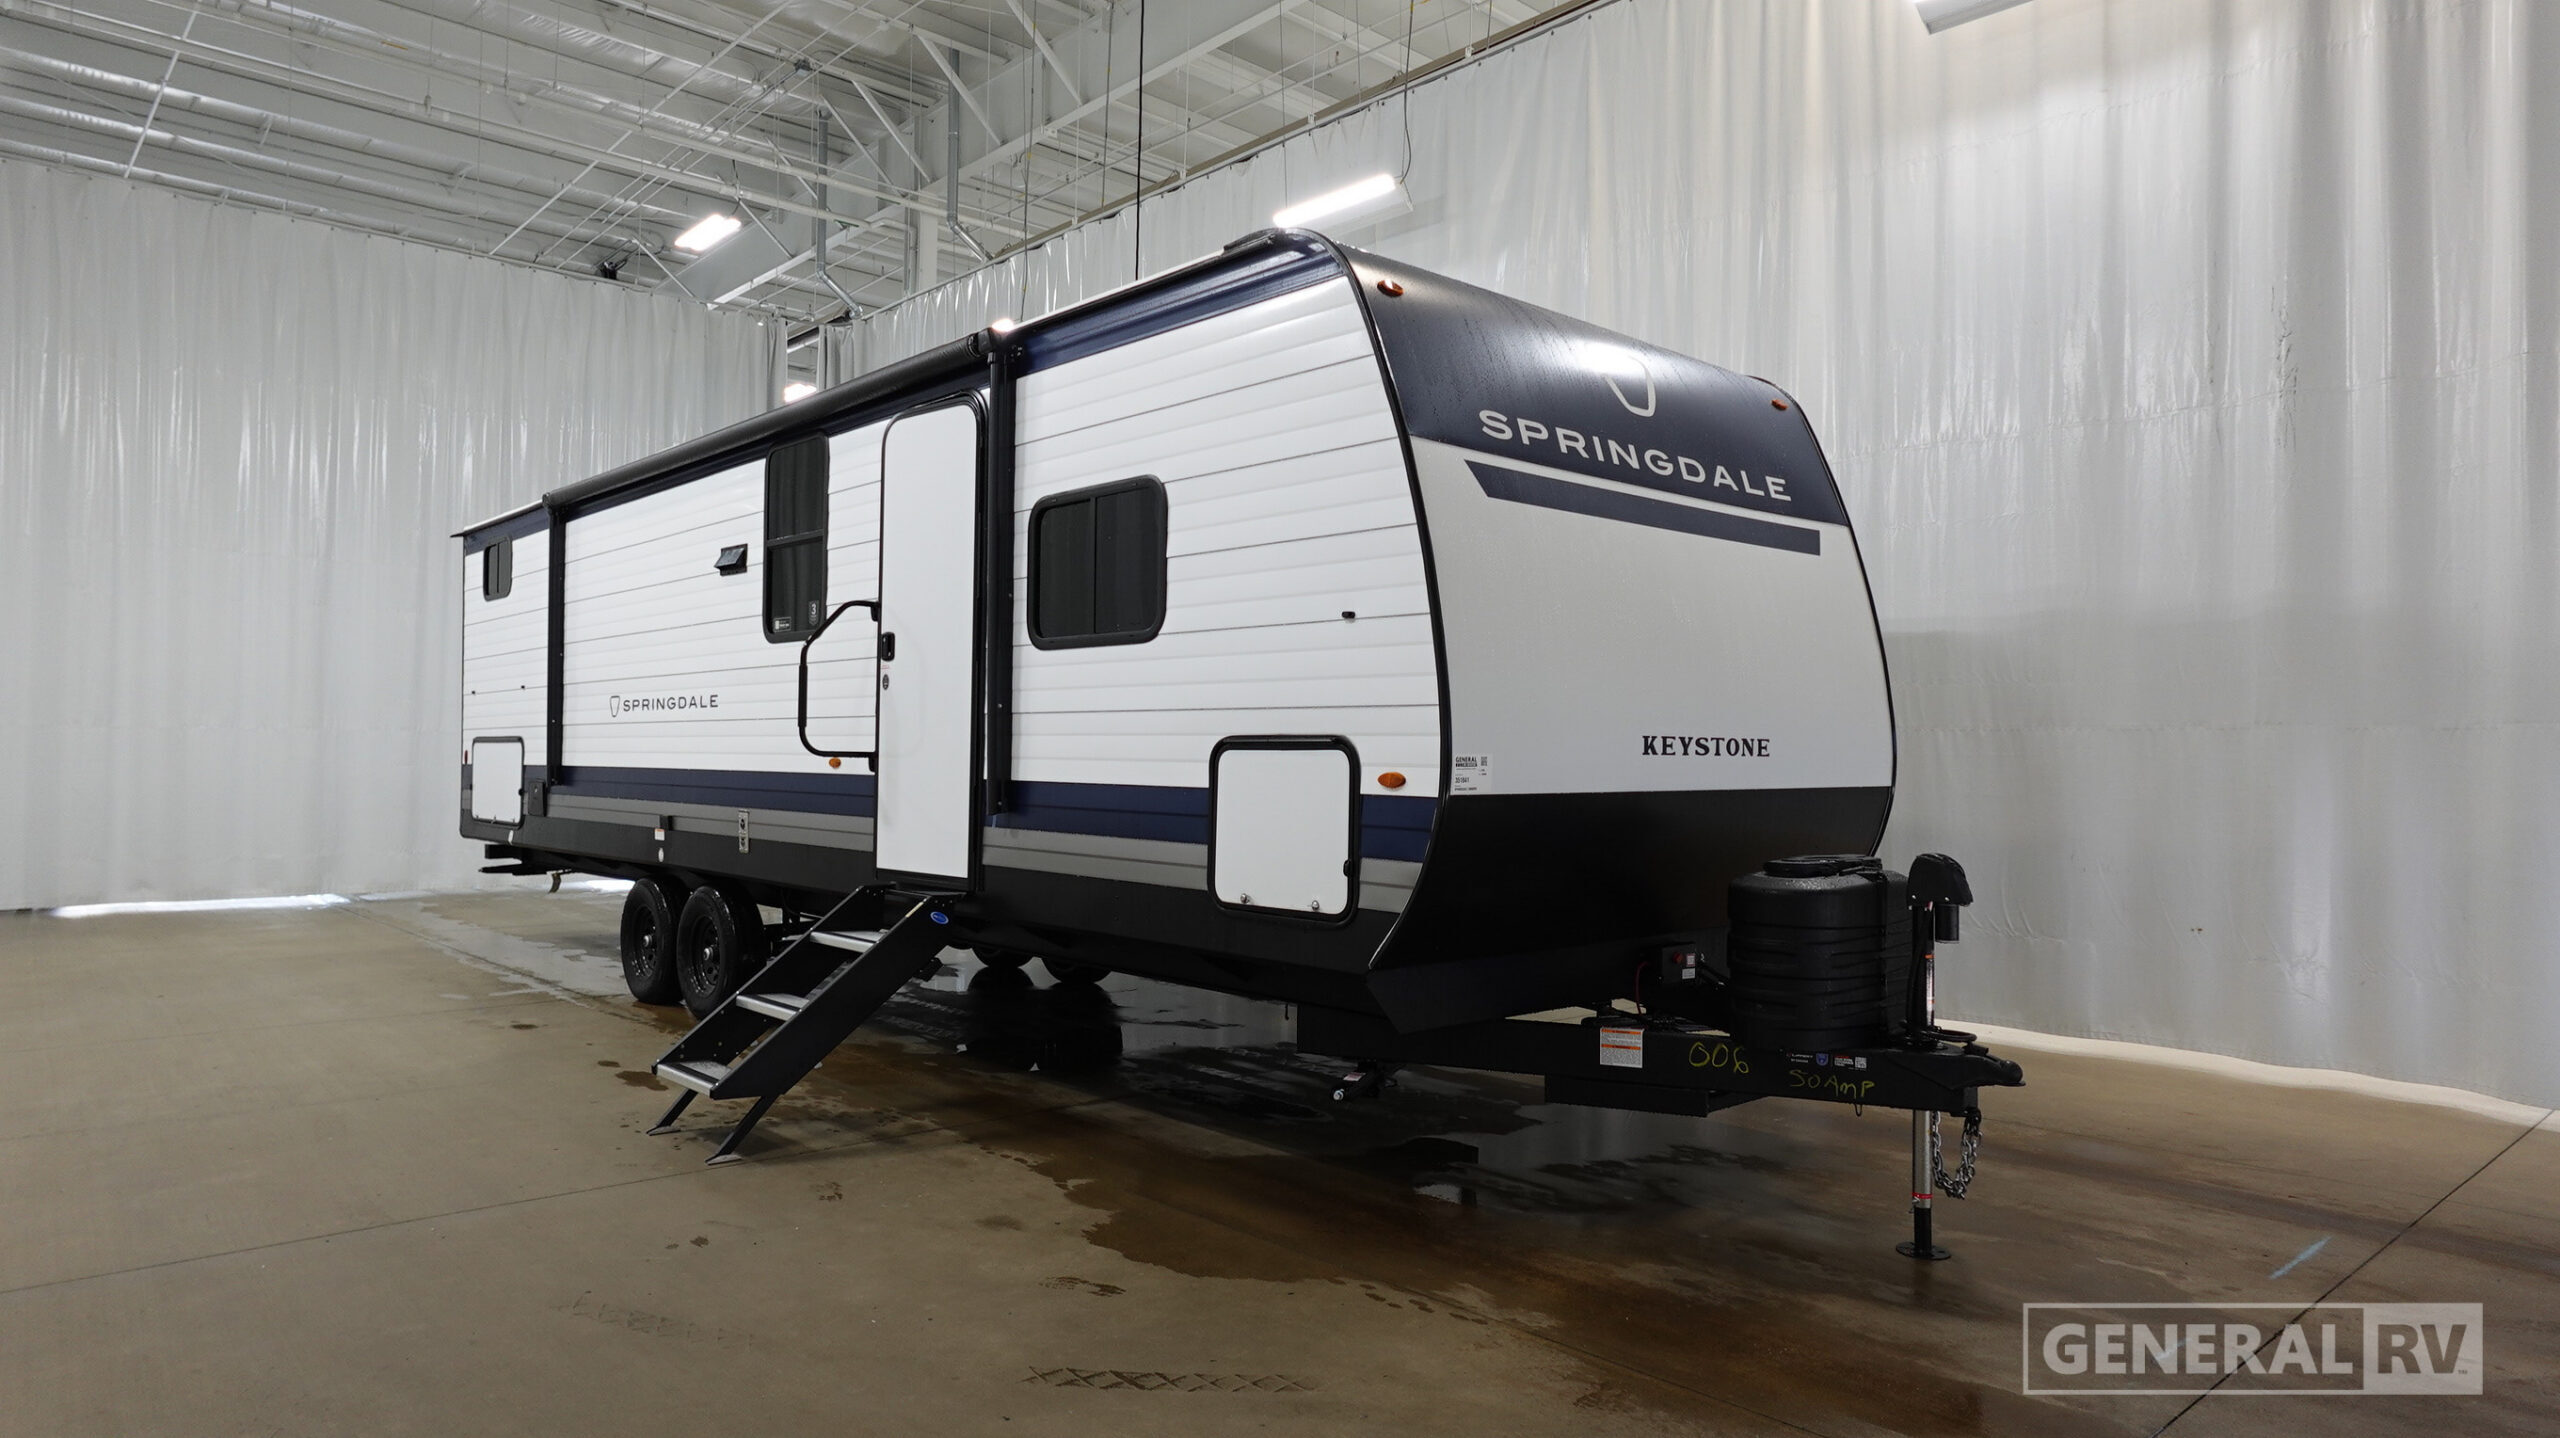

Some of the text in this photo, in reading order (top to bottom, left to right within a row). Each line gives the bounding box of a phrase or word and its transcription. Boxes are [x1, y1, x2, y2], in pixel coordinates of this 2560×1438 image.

[1478, 409, 1792, 502] SPRINGDALE
[623, 694, 719, 712] SPRINGDALE
[1642, 735, 1770, 757] KEYSTONE
